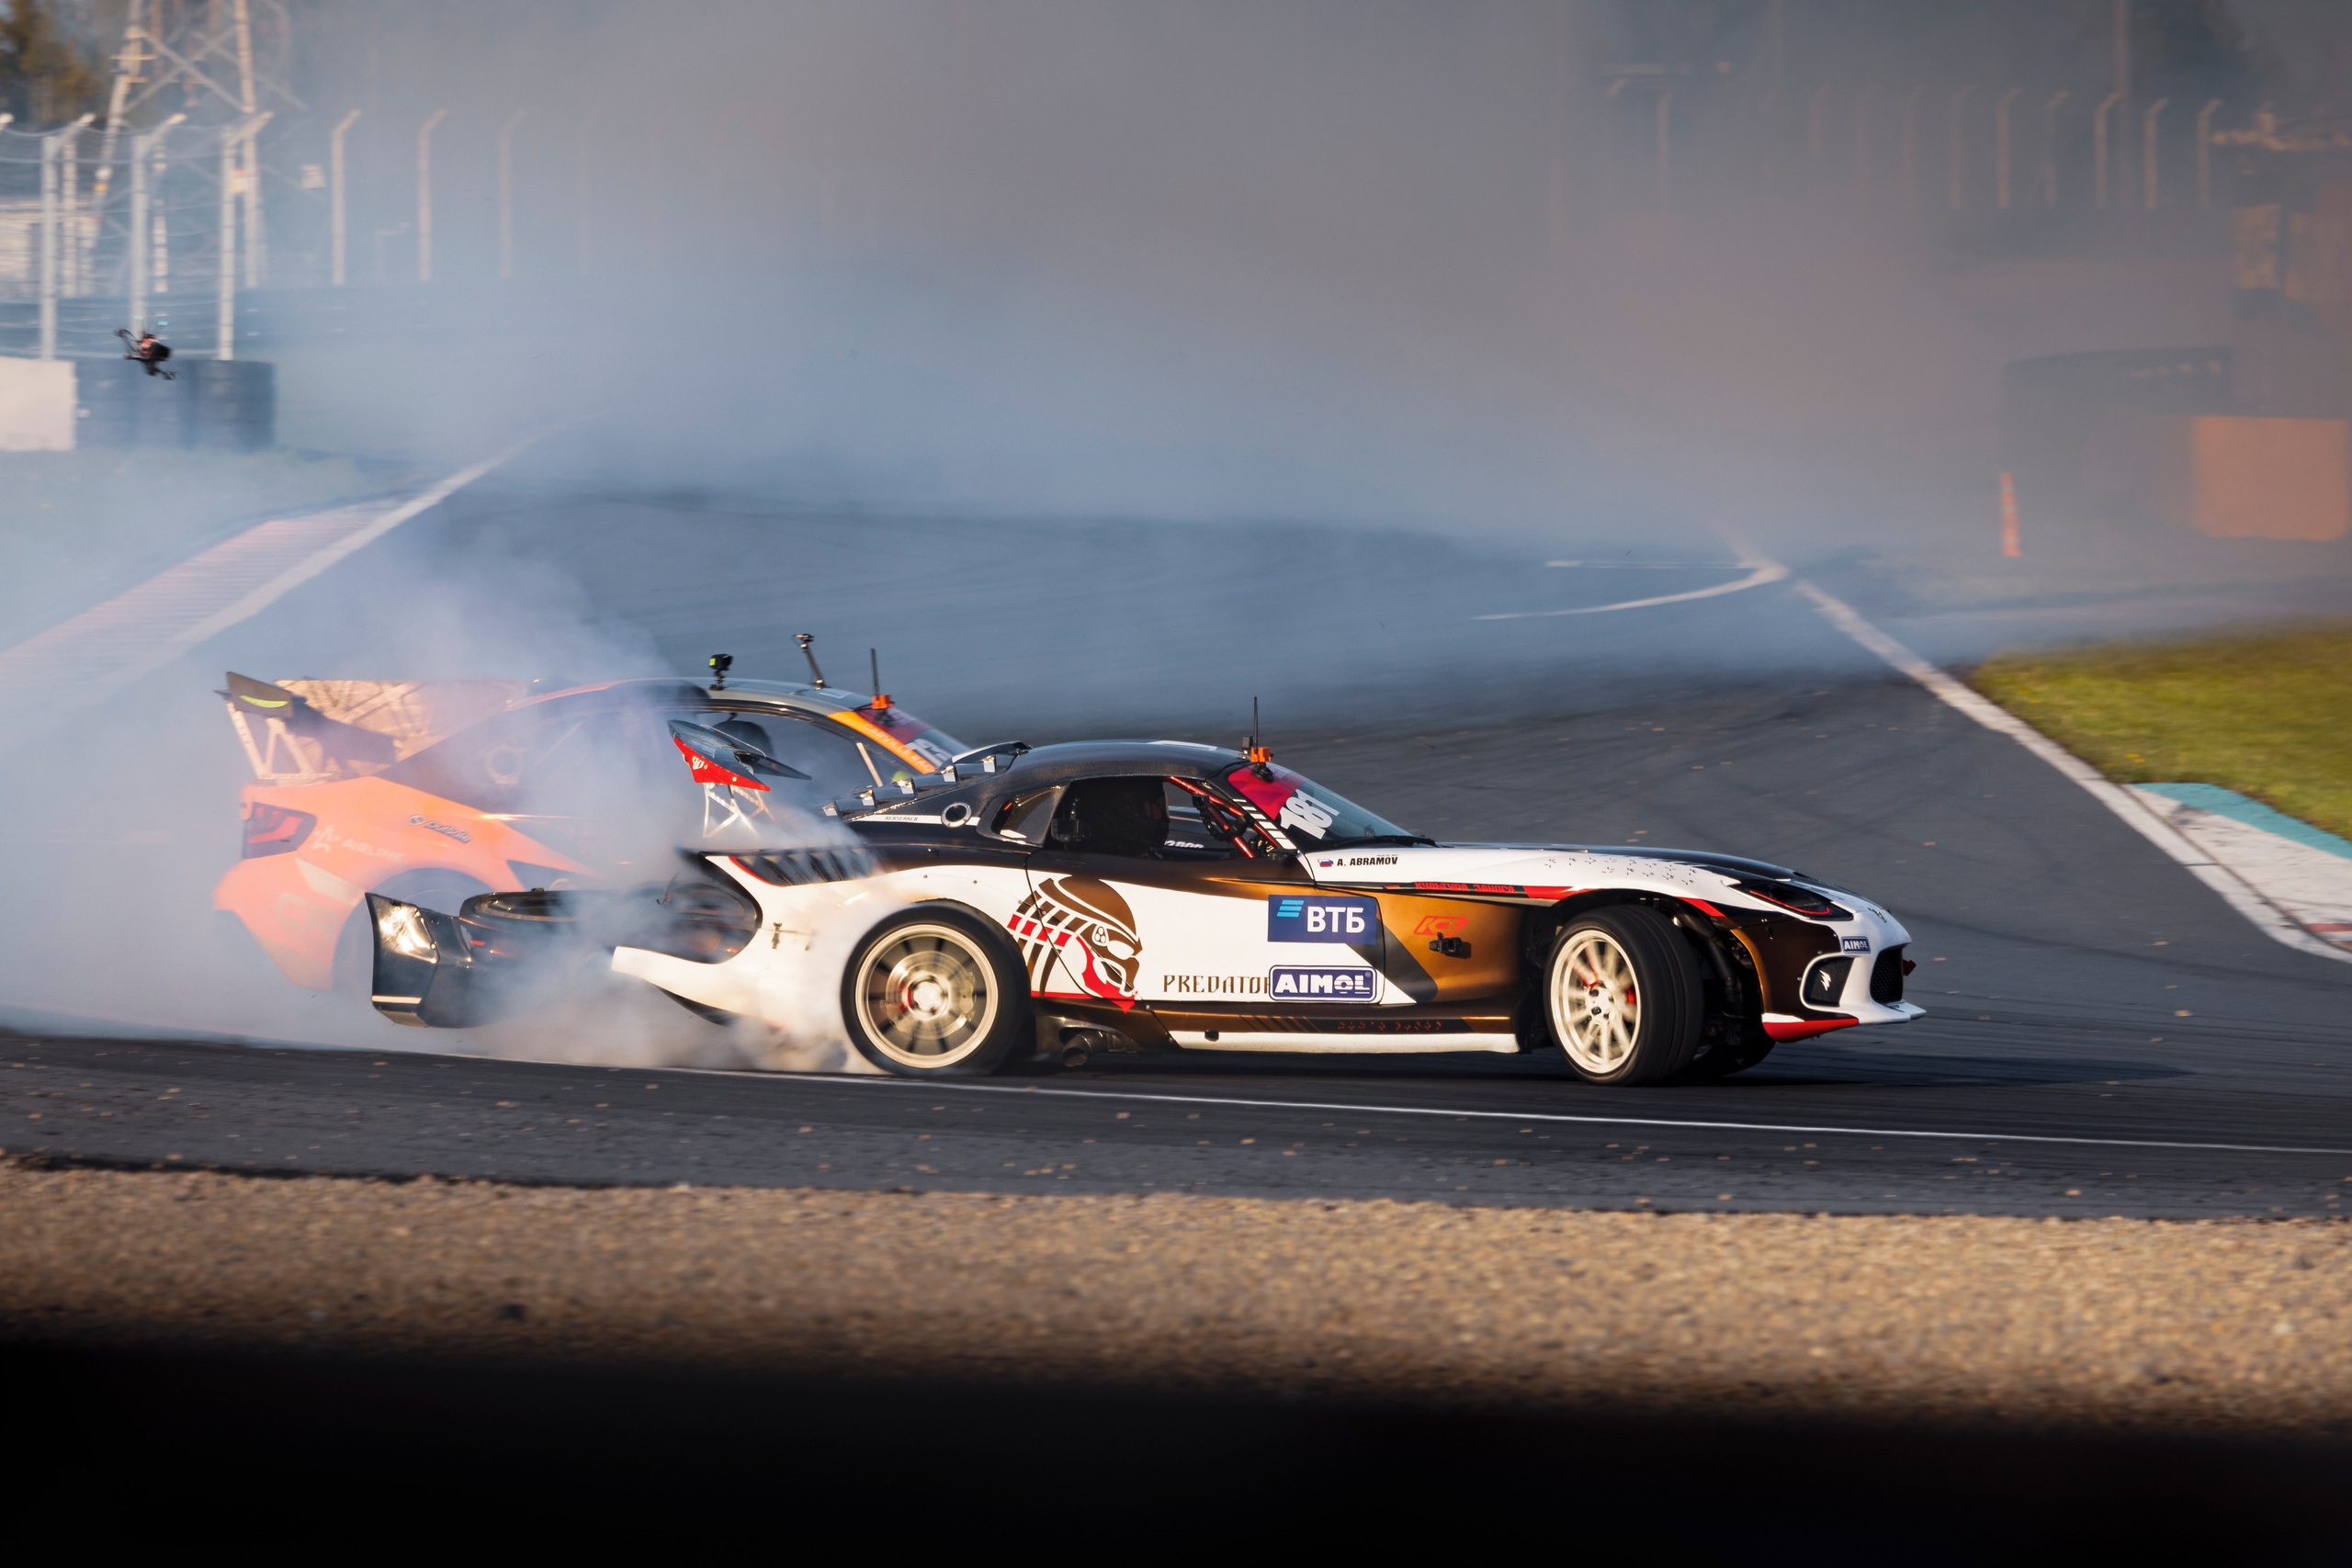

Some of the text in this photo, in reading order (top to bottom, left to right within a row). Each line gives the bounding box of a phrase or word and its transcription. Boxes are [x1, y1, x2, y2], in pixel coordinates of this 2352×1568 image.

[1279, 789, 1340, 840] 181
[341, 839, 404, 862] AIRLINE
[1337, 857, 1397, 866] A. ABRAMOV
[1415, 882, 1517, 895] КУЛЬТУРА ЗАНОСА
[1306, 906, 1366, 933] ВТБ
[1843, 940, 1869, 951] AIMOL
[1163, 975, 1270, 994] PREDATO
[1274, 974, 1371, 995] AIMOL
